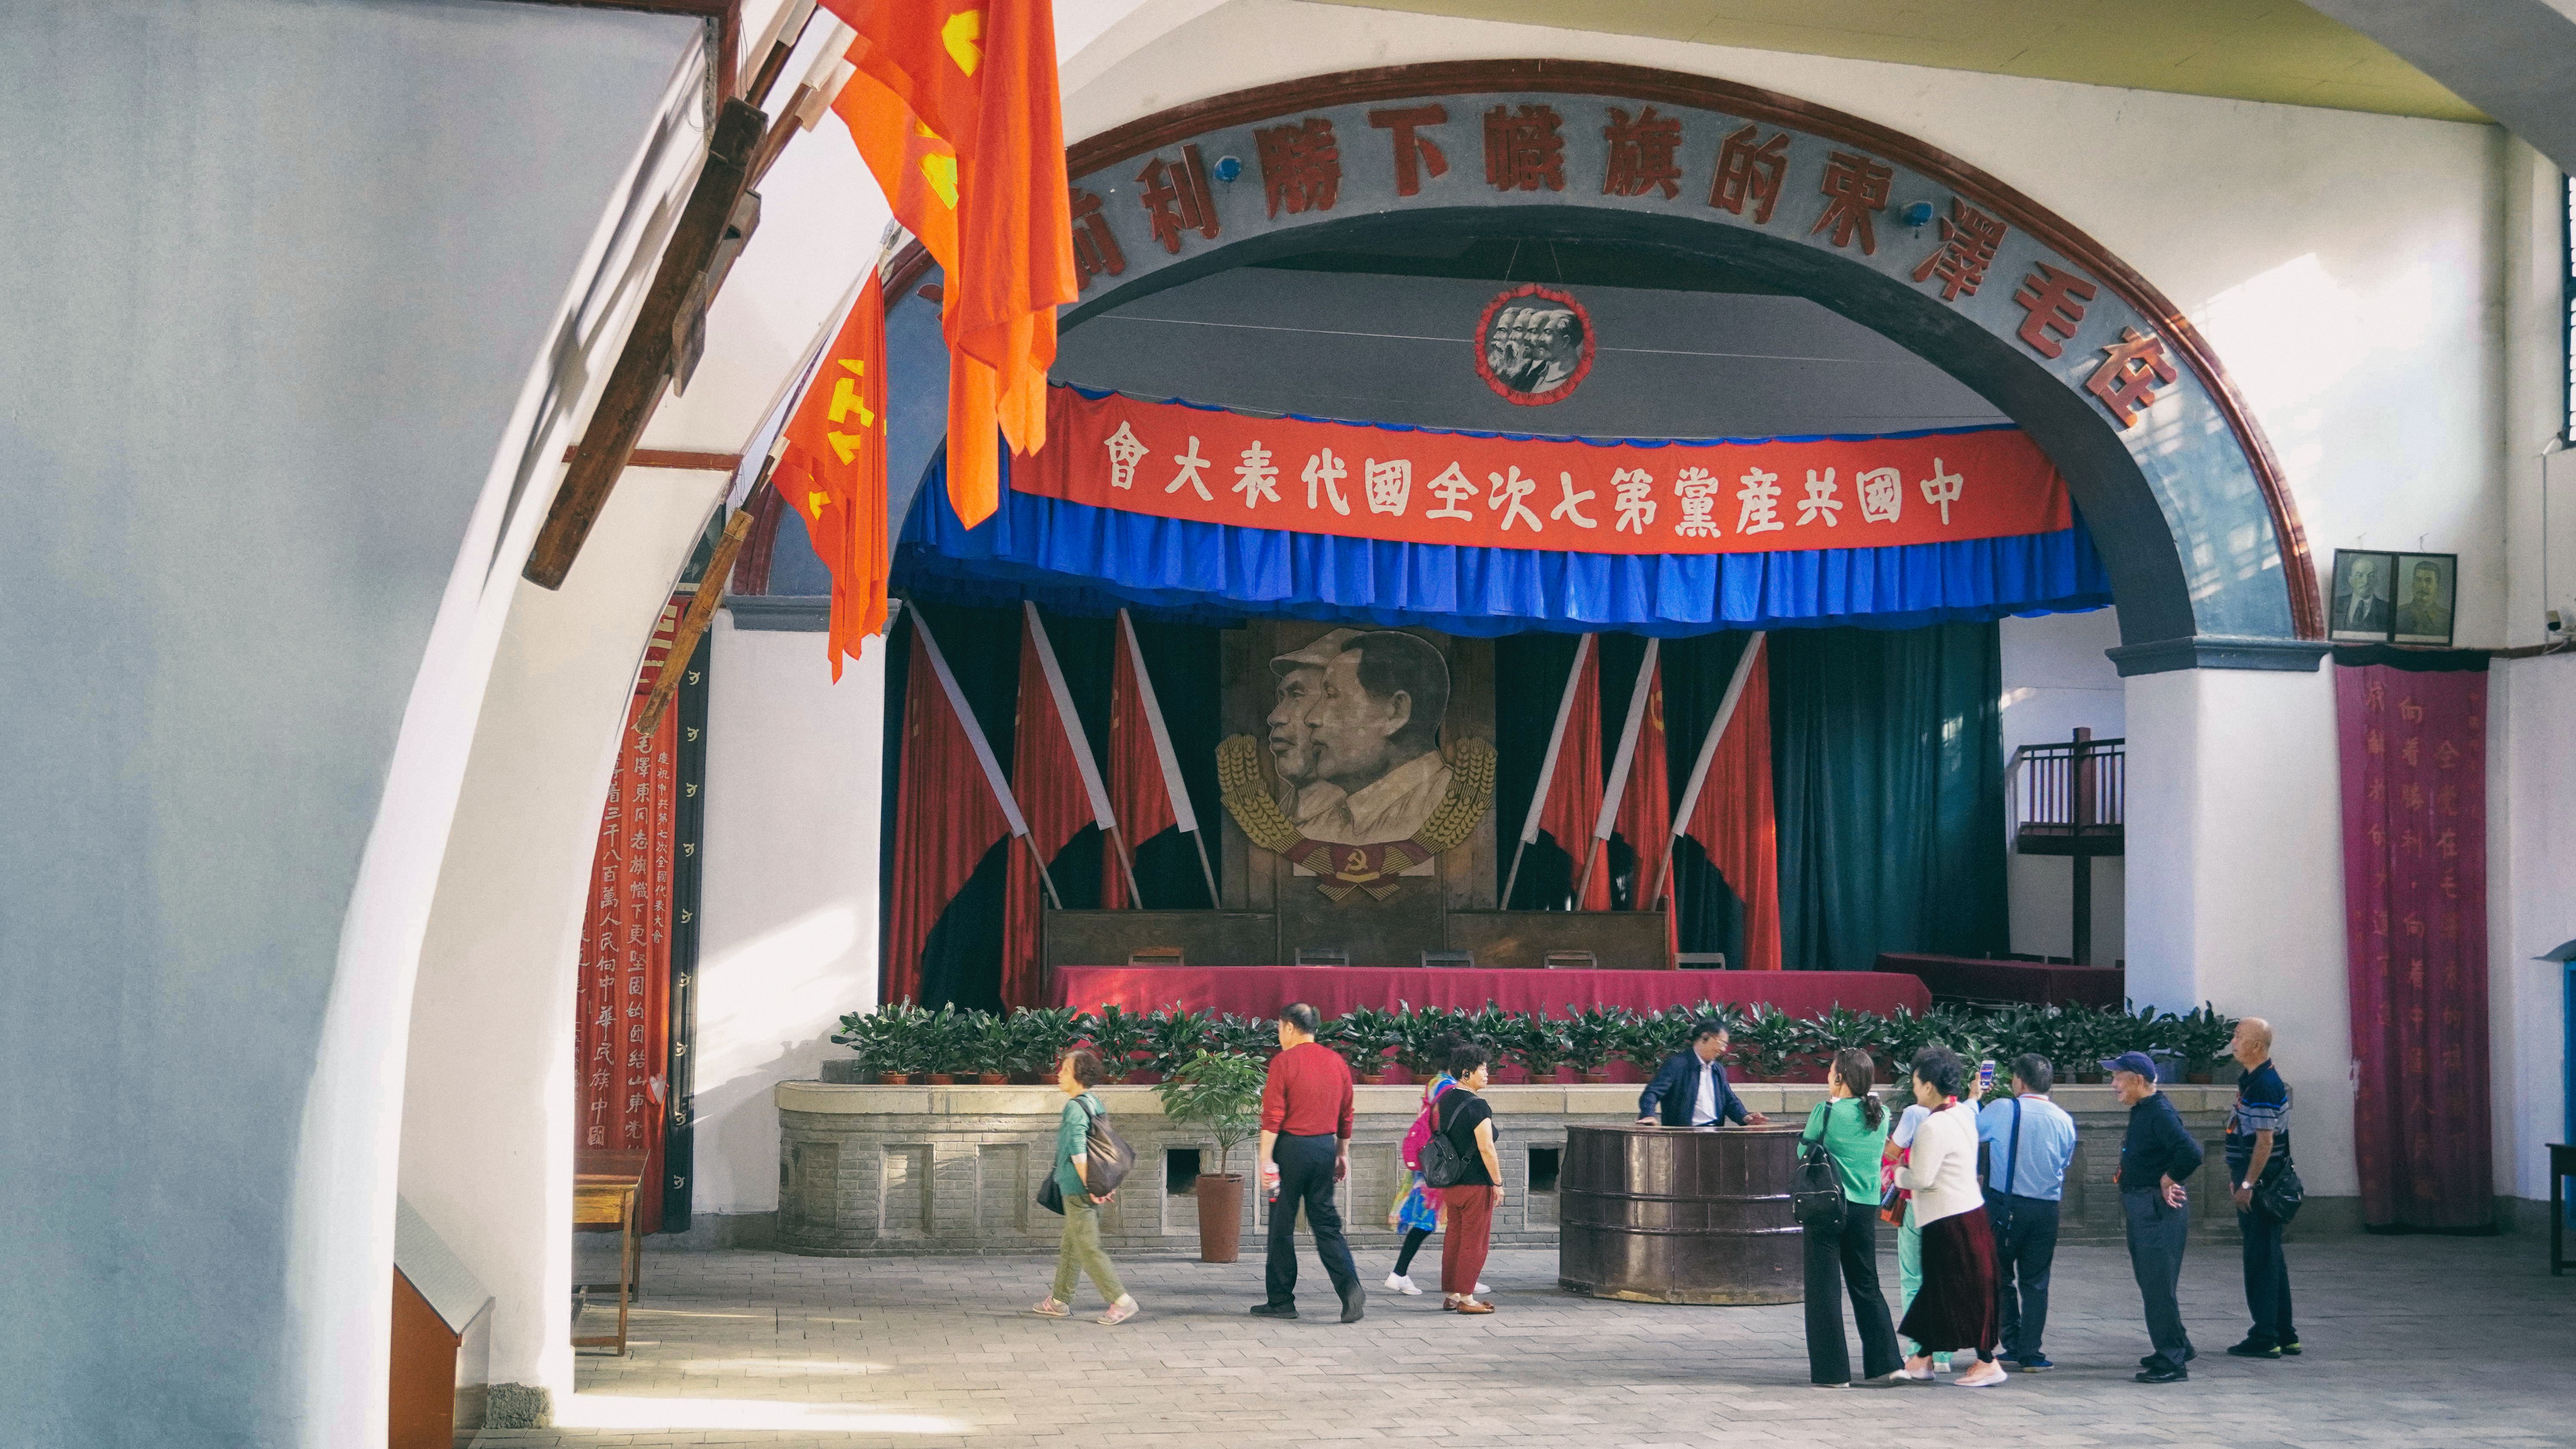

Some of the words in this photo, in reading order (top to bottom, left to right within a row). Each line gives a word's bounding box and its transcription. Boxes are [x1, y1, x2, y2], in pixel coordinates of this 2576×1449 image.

[917, 103, 2178, 428] 在毛澤東的旗幟下勝利前
[587, 747, 624, 1147] 着三千八百萬人民向中華民族中國
